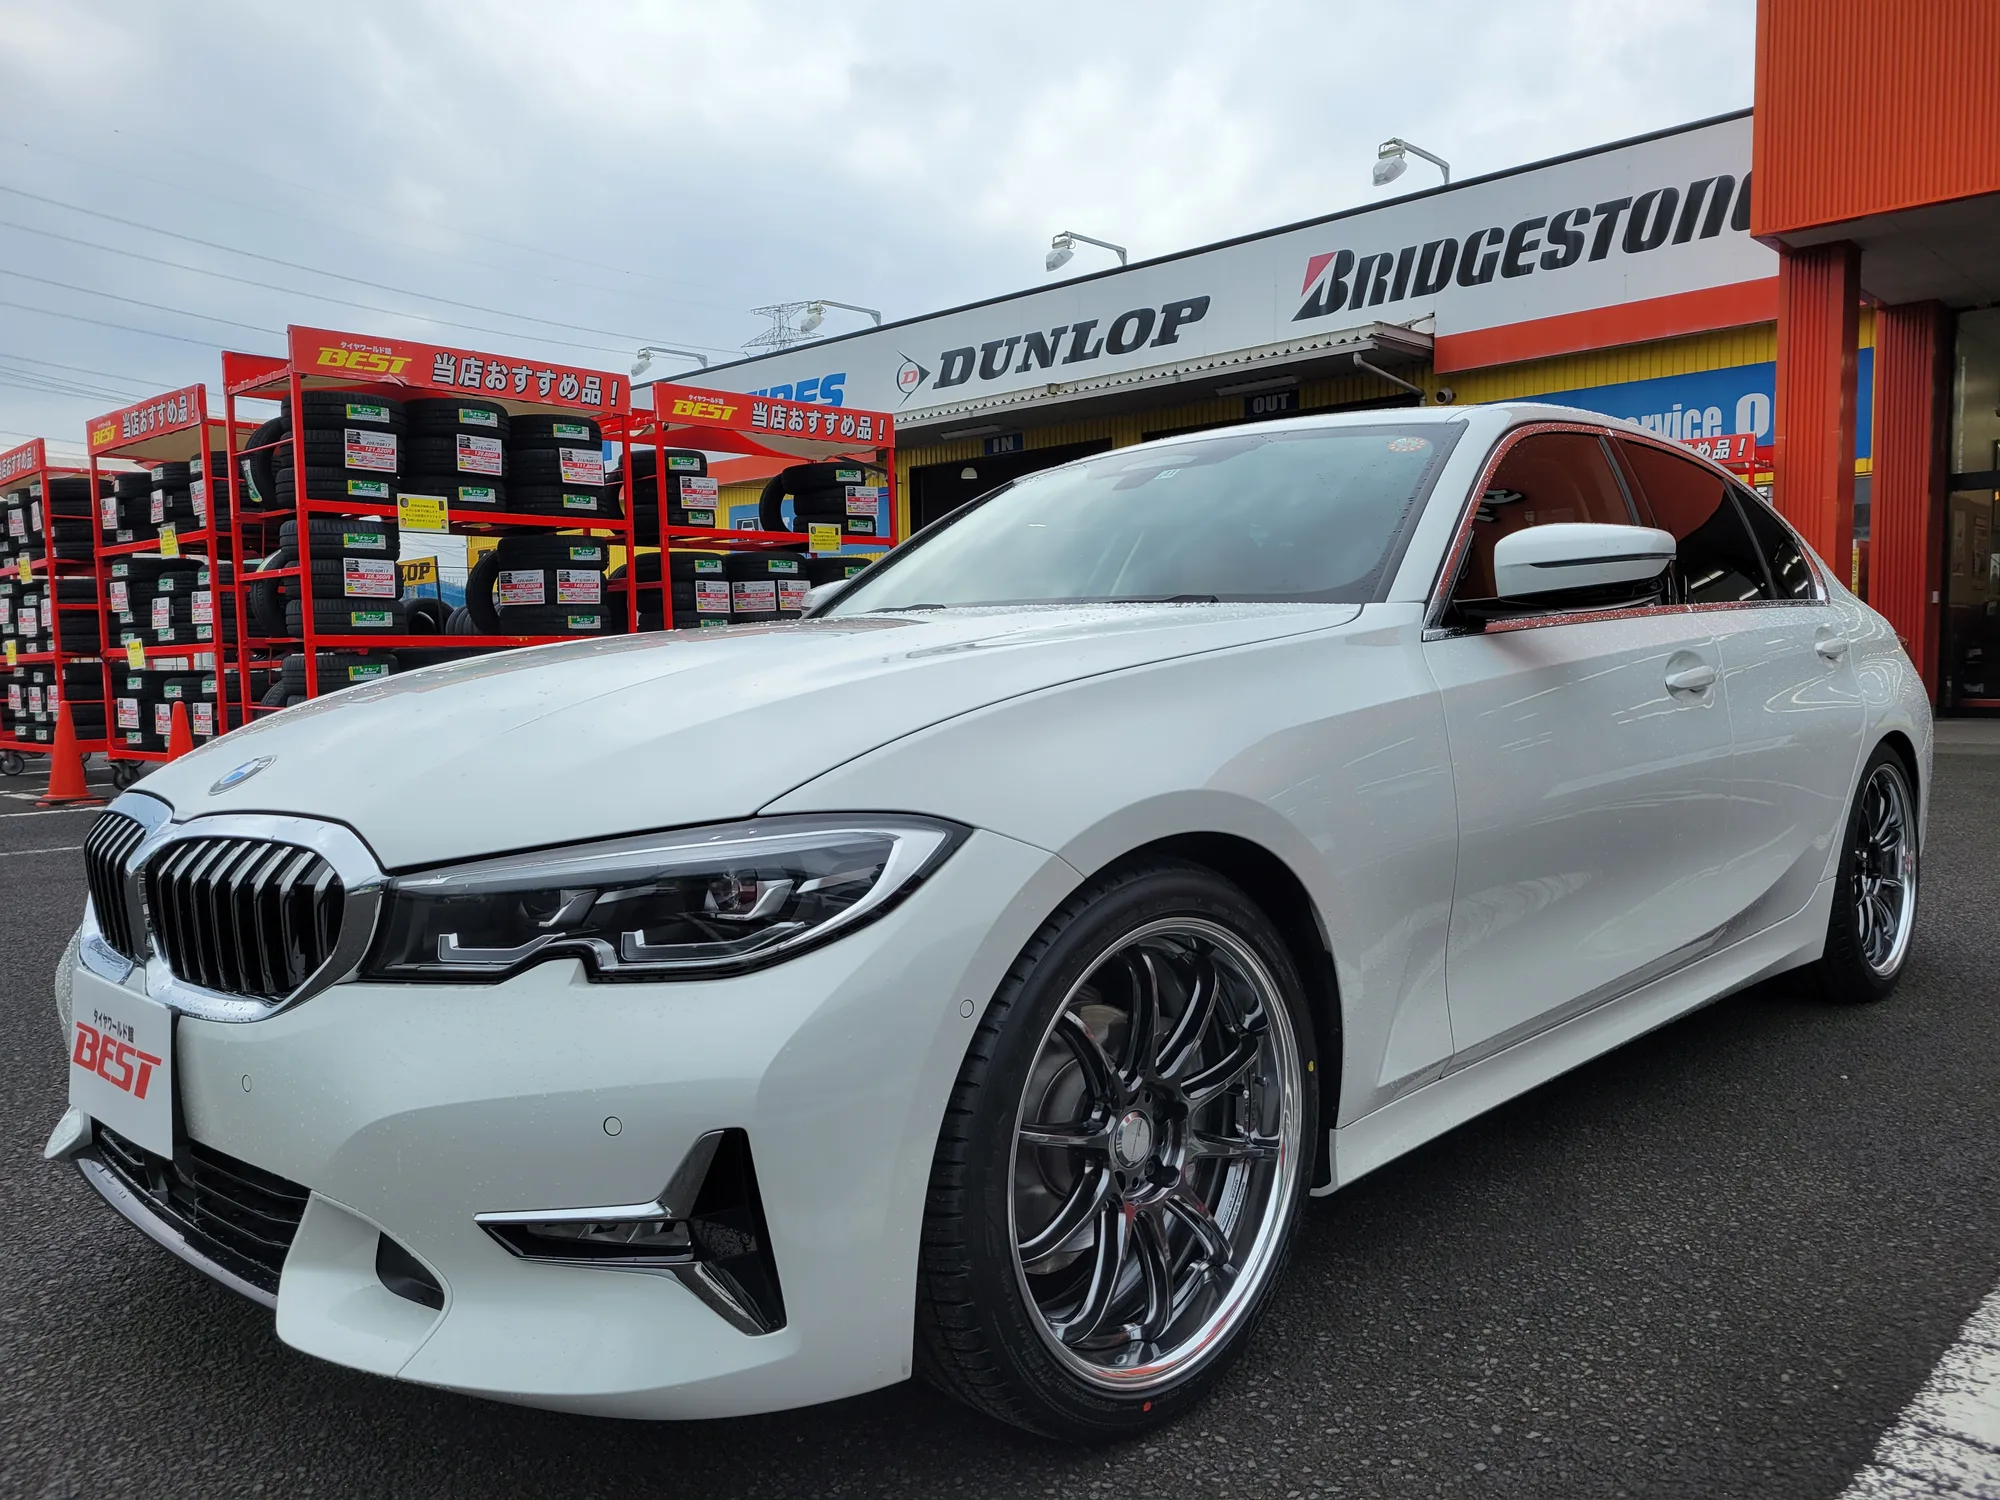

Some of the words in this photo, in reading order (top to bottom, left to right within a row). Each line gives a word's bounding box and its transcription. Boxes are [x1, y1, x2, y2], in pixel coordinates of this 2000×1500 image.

[932, 295, 1211, 390] DUNLOP
[316, 347, 412, 374] BEST
[431, 352, 619, 407] 当店おすすめ品！
[122, 393, 196, 439] 当店おすすめ品！
[672, 399, 738, 421] BEST
[751, 401, 885, 440] 当店おすすめ品！
[1252, 393, 1290, 415] OUT
[92, 425, 117, 446] BEST
[992, 435, 1015, 453] IN
[0, 445, 37, 479] 店おすすめ品！
[93, 1008, 135, 1043] タイヤワールド館
[72, 1021, 162, 1100] BEST
